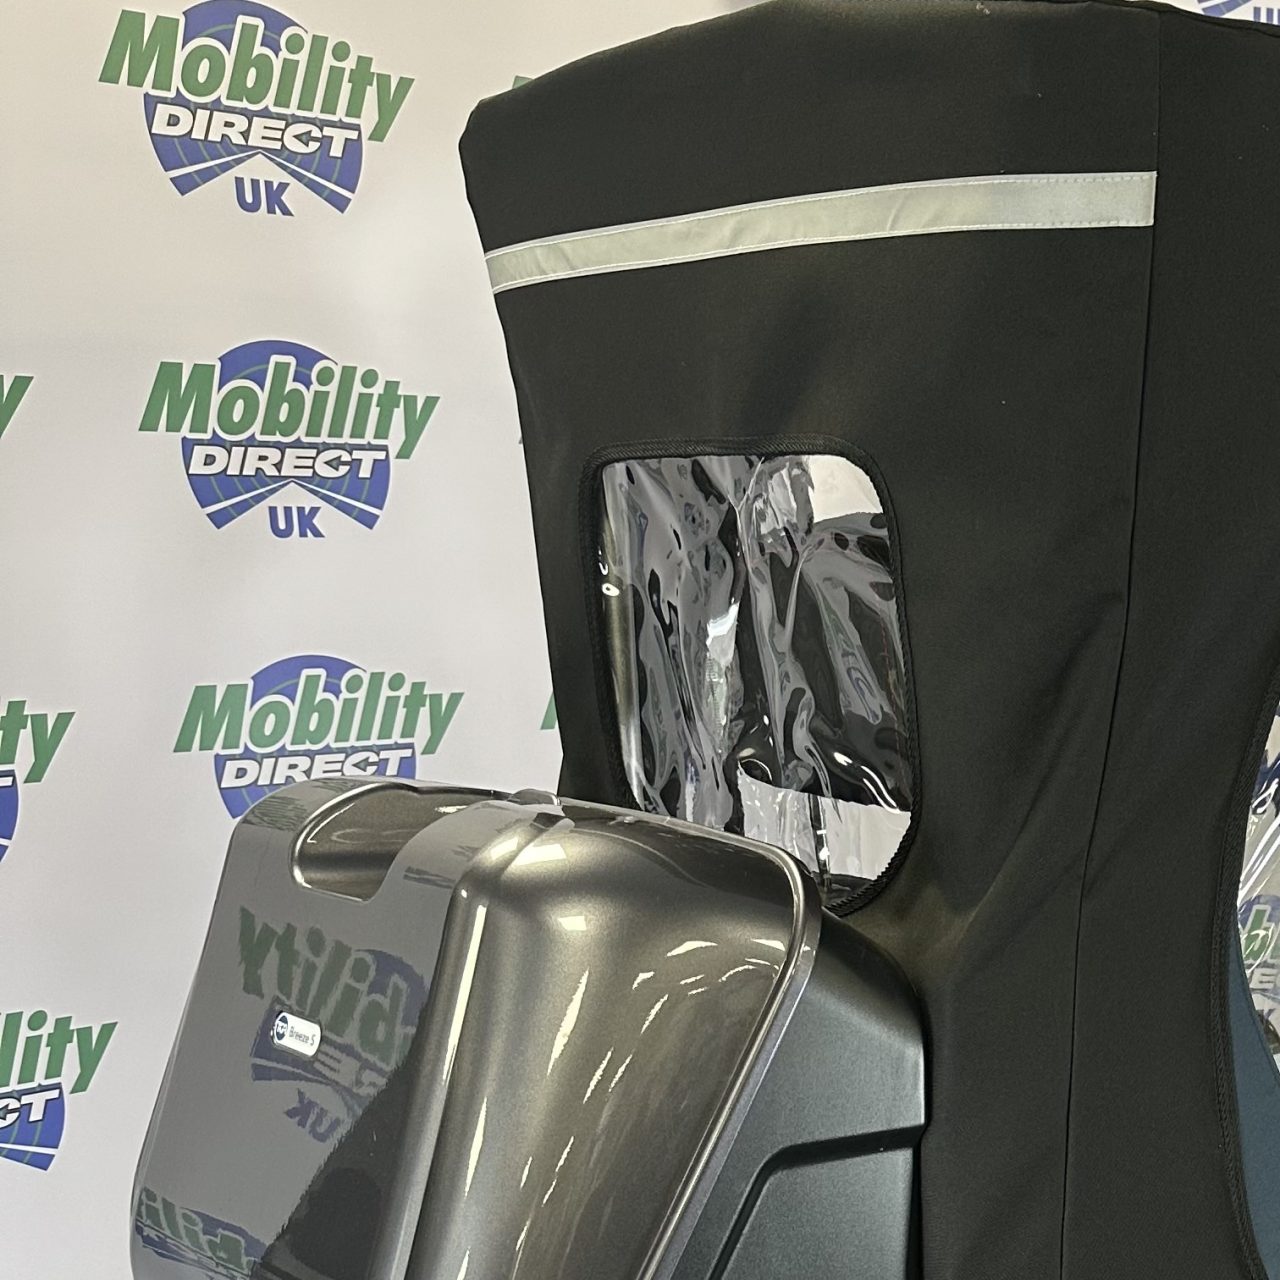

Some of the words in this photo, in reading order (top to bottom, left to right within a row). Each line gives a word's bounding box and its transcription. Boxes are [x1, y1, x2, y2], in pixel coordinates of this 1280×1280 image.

[98, 9, 415, 142] Mobility
[151, 105, 359, 158] DIRECT
[234, 176, 294, 217] UK
[138, 361, 440, 459] Mobility
[188, 445, 386, 479] DIRECT
[268, 505, 325, 538] UK
[173, 672, 464, 755] Mobility
[220, 749, 413, 788] DIRECT
[0, 1010, 118, 1094] lity
